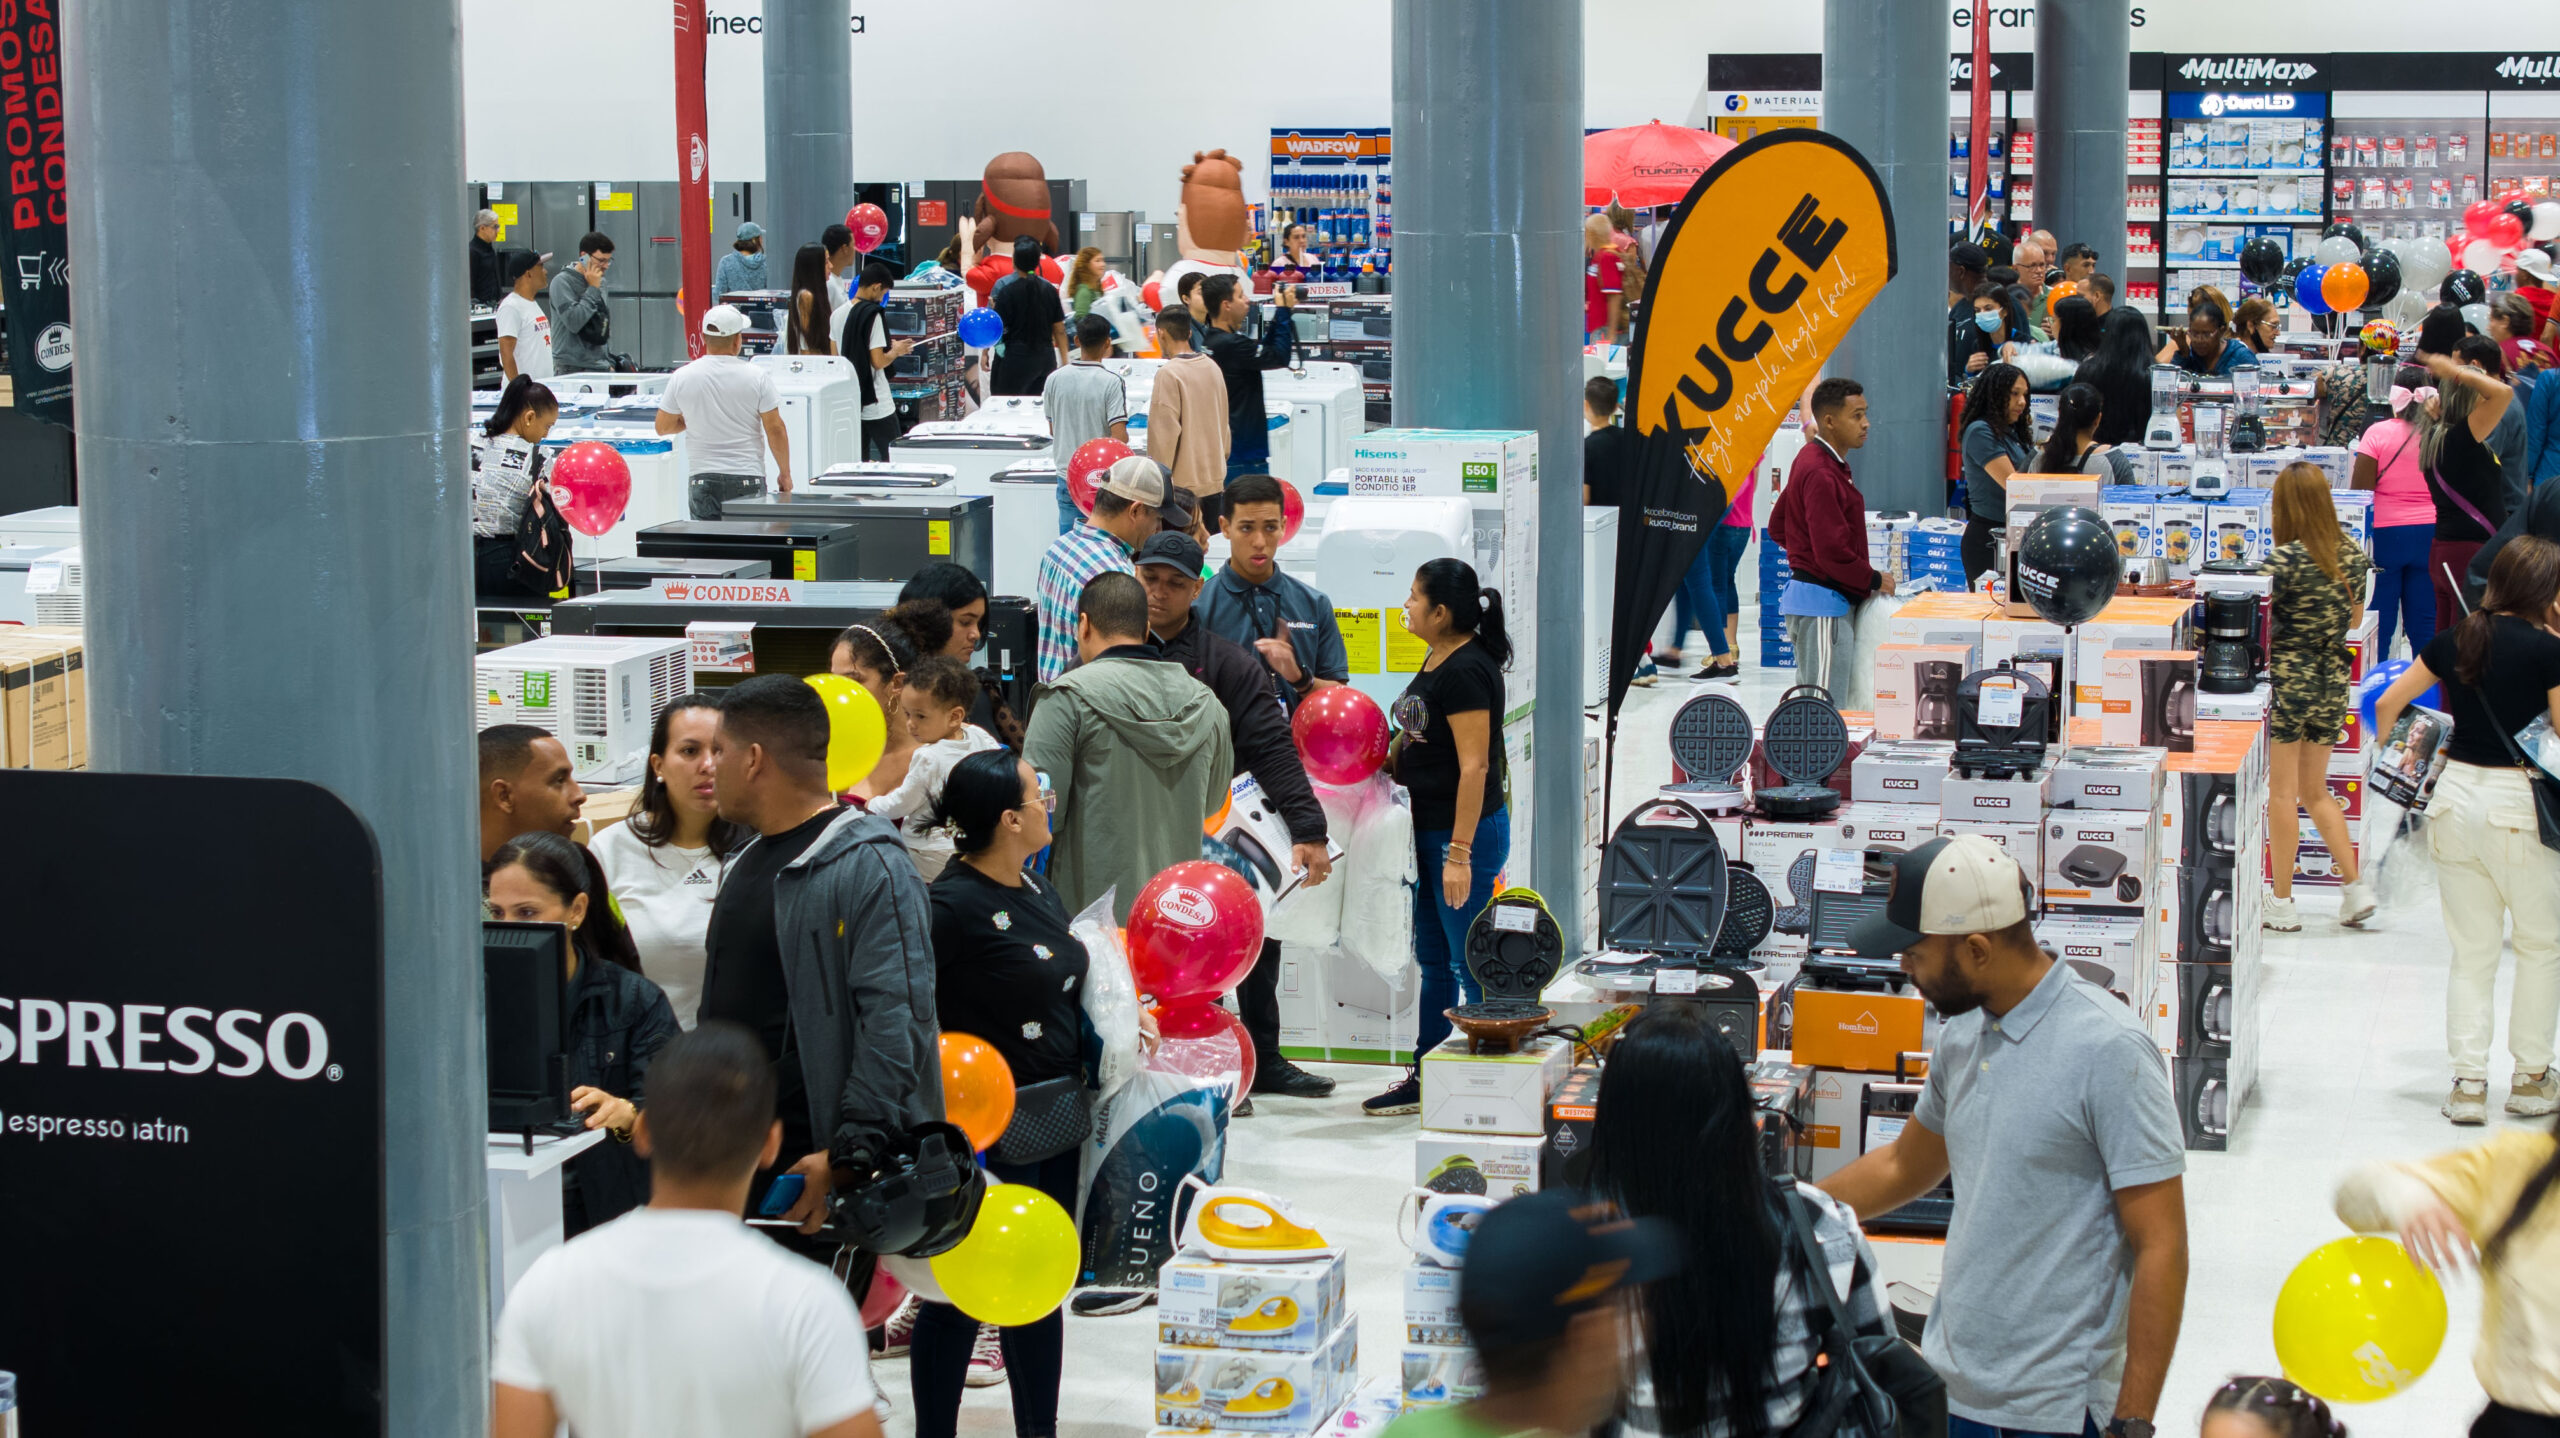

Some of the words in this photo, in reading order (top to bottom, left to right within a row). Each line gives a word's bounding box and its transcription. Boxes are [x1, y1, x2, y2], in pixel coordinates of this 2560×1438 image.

[706, 10, 762, 34] ínea
[2185, 58, 2306, 79] MultiMax
[1286, 141, 1360, 154] WADFOW
[1638, 168, 1702, 176] TUNDRA
[1306, 286, 1347, 295] NDESA
[1648, 192, 1849, 448] KUCCE
[40, 343, 71, 360] CONDES
[1355, 449, 1407, 459] Hisense
[1465, 465, 1489, 475] 550
[1355, 475, 1398, 484] PORTABLE
[2018, 562, 2059, 588] KUCCE
[694, 586, 791, 602] CONDESA
[526, 680, 546, 699] 55
[1884, 779, 1917, 788] KUCCE
[2086, 786, 2120, 795] KUCCE
[1975, 798, 2009, 807] KUCCE
[1766, 831, 1814, 839] PREMIER
[1870, 831, 1904, 840] KUCCE
[2080, 832, 2113, 841] KUCCE
[1160, 900, 1206, 924] CONDESA
[2067, 946, 2100, 956] KUCCE
[1838, 1022, 1876, 1032] HomEver
[8, 1114, 125, 1142] espresso
[1127, 1171, 1158, 1283] SUEÑO
[1173, 1315, 1190, 1323] 9.99
